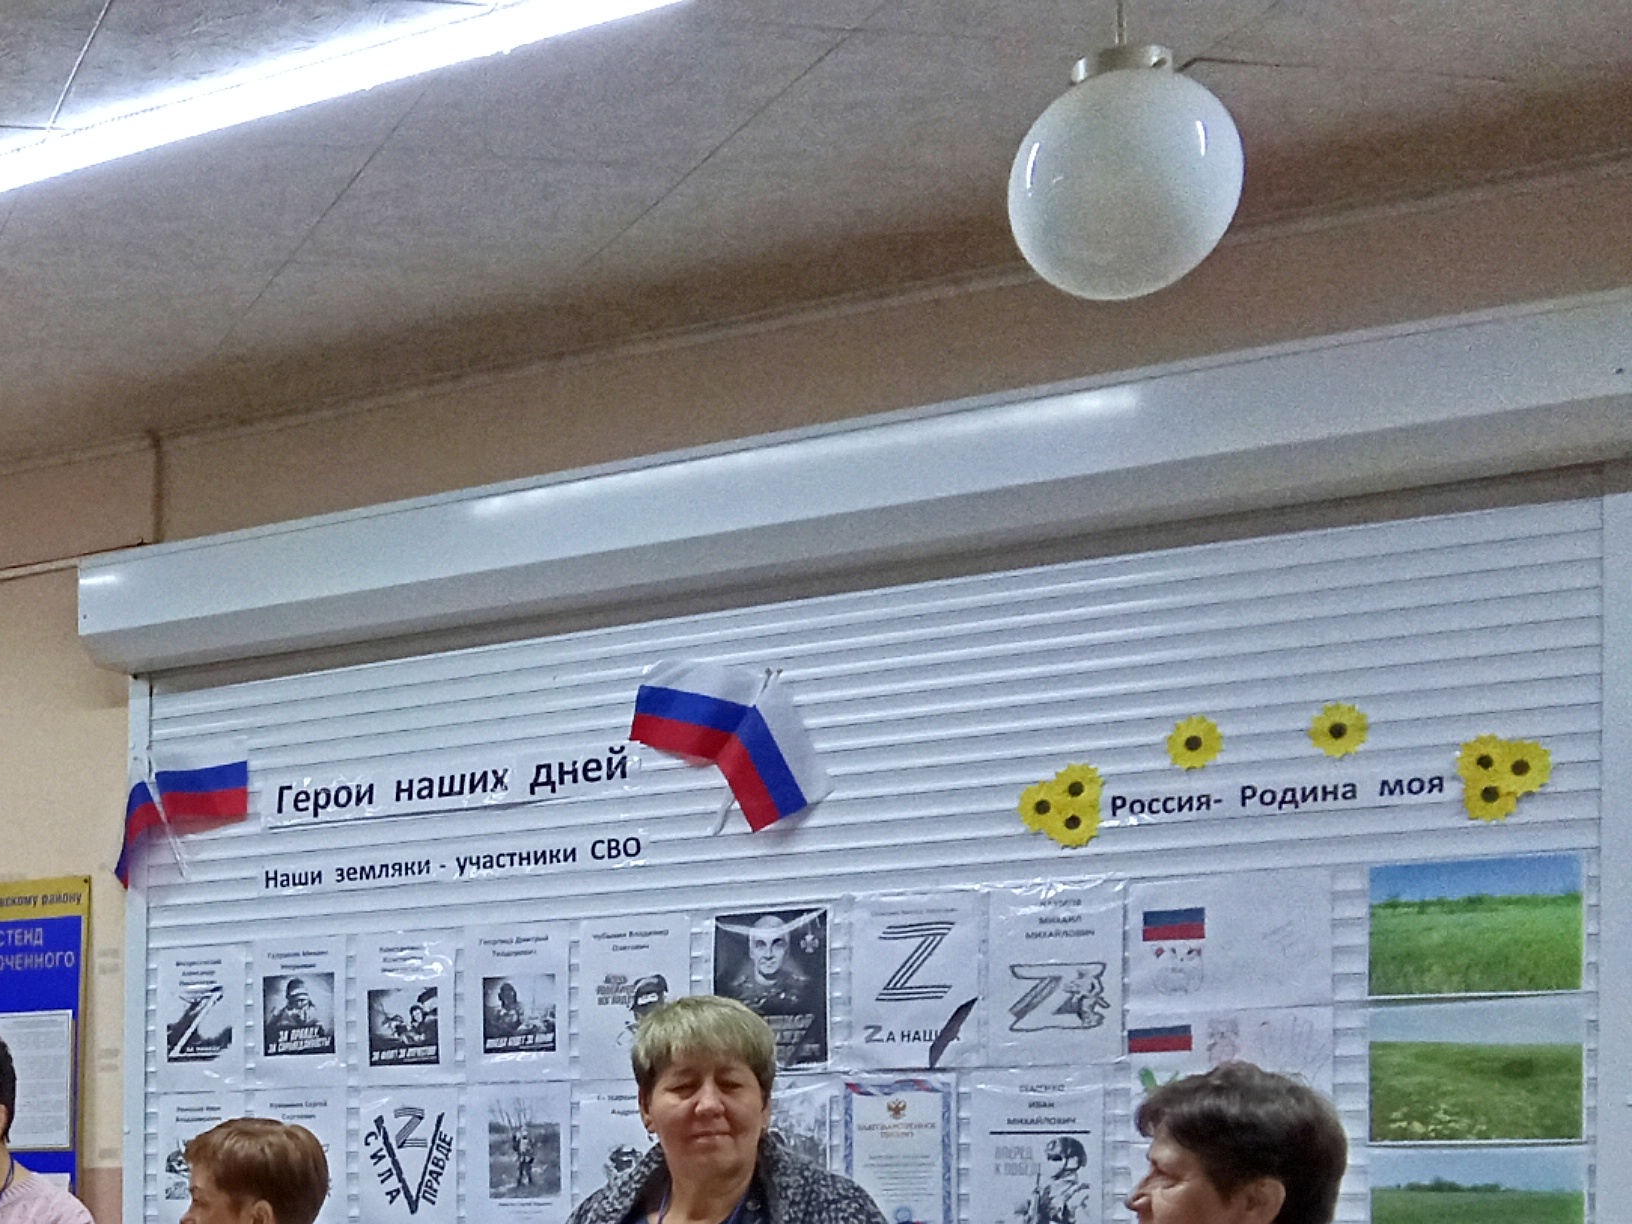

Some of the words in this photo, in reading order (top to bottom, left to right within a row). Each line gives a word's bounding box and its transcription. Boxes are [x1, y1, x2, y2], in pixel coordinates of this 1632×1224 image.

[277, 783, 374, 817] Герои
[395, 767, 509, 801] наших
[529, 746, 628, 795] дней
[1240, 782, 1358, 810] Родина
[1379, 775, 1444, 796] моя
[264, 868, 322, 889] Наши
[335, 859, 431, 883] земляки
[456, 846, 576, 876] участники
[591, 836, 641, 860] СВО
[901, 1029, 960, 1043] НАШ
[364, 1131, 402, 1205] СИЛА
[421, 1130, 453, 1206] ПРАВДЕ
